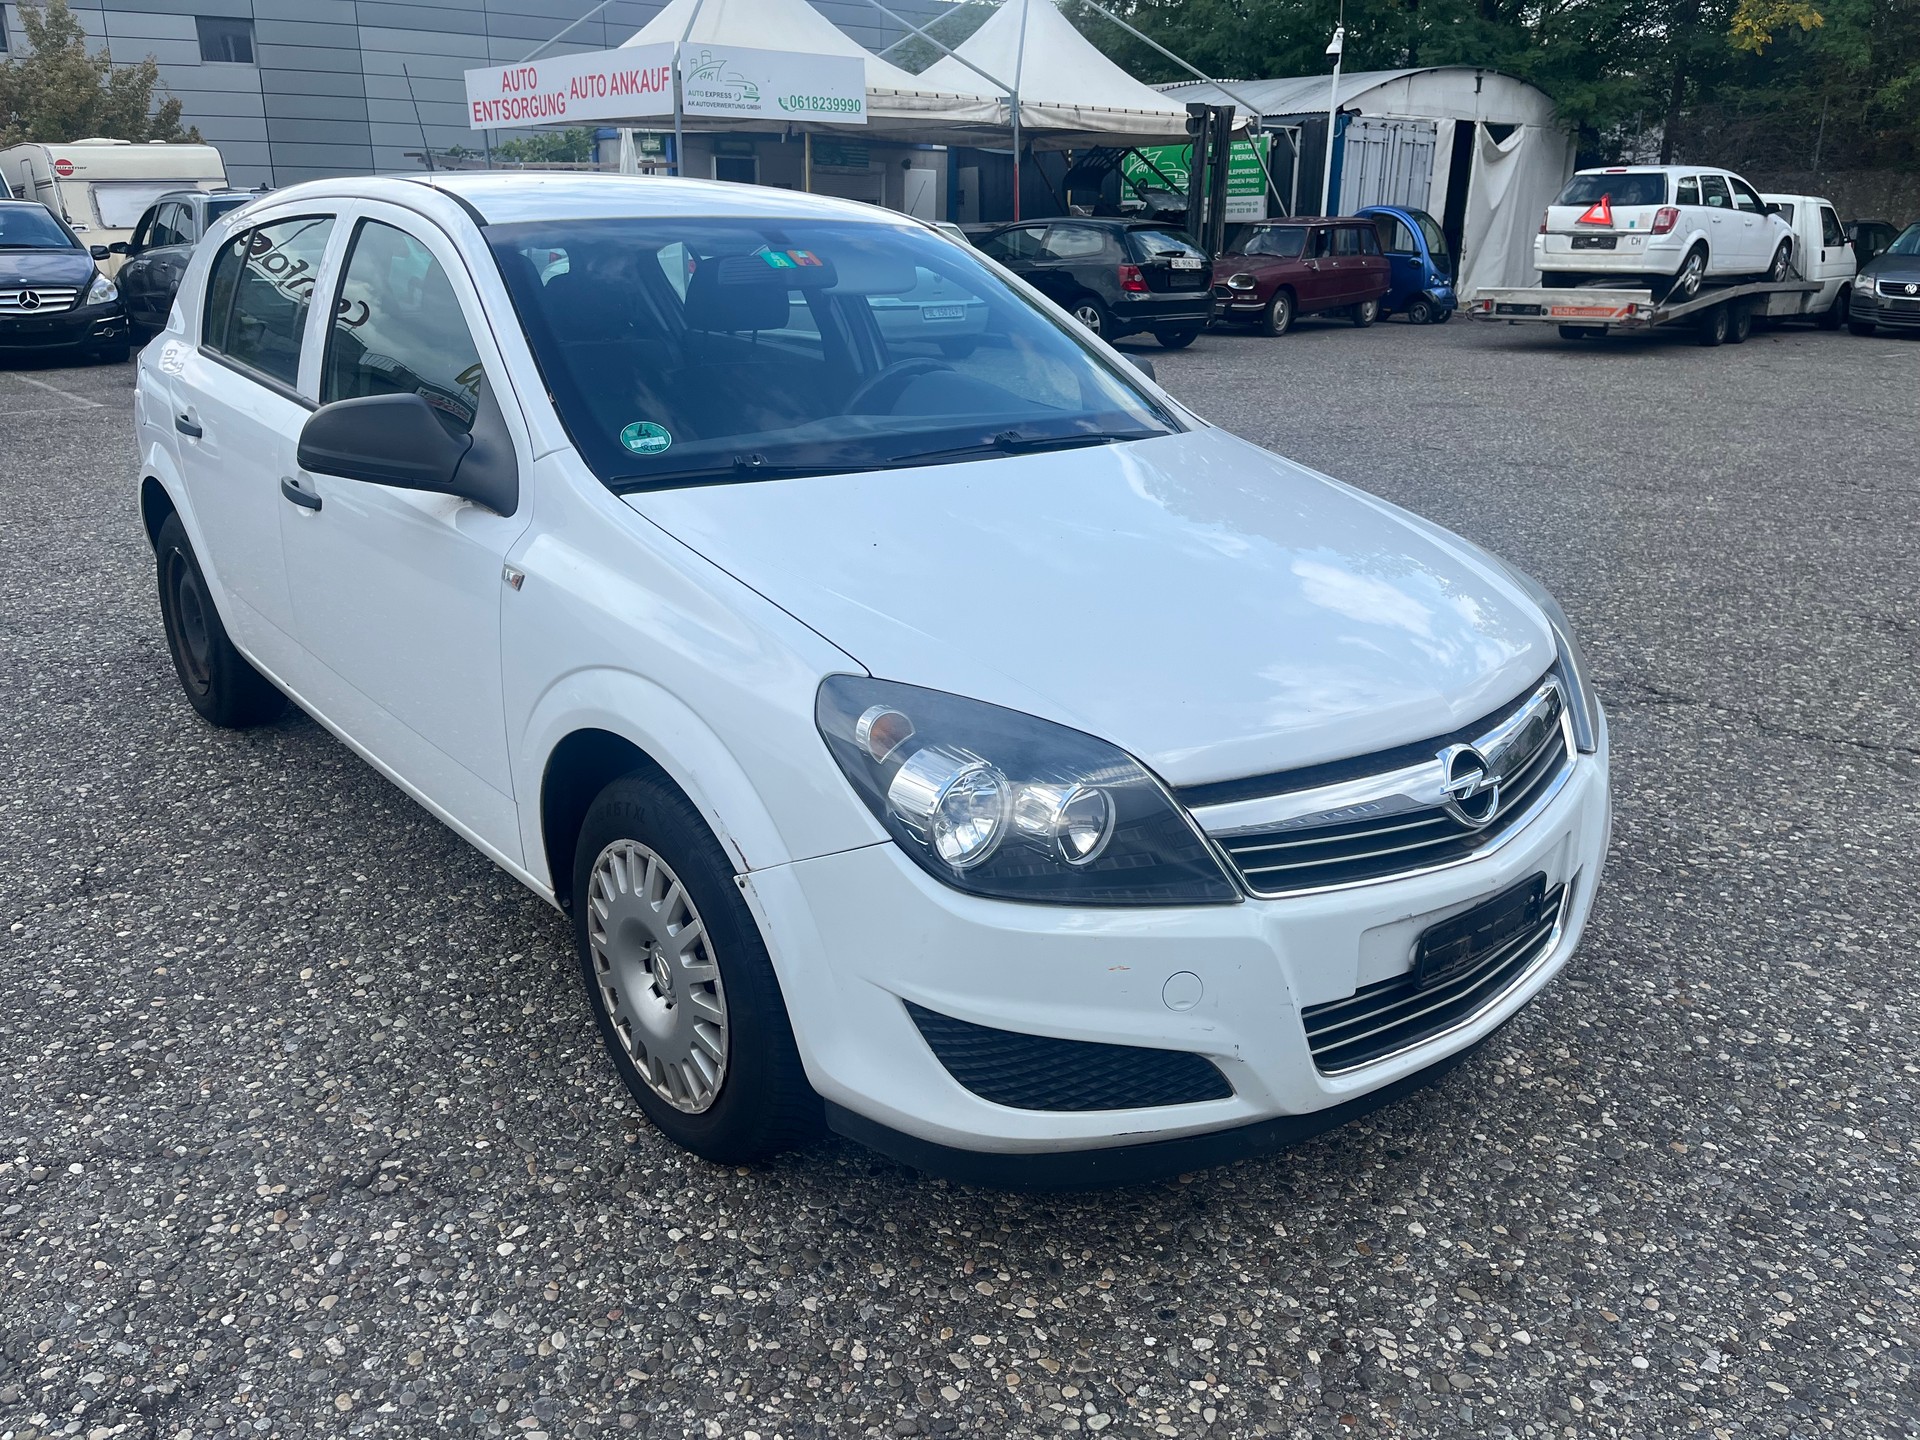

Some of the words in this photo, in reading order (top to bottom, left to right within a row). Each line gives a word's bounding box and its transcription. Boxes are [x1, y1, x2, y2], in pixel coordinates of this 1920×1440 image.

[501, 67, 538, 93] AUTO
[569, 73, 607, 100] AUTO
[609, 66, 671, 97] ANKAUF
[705, 91, 732, 99] EXPRESS
[790, 94, 861, 112] 0618239990
[472, 92, 566, 123] ENTSORGUNG
[1631, 236, 1642, 246] CH
